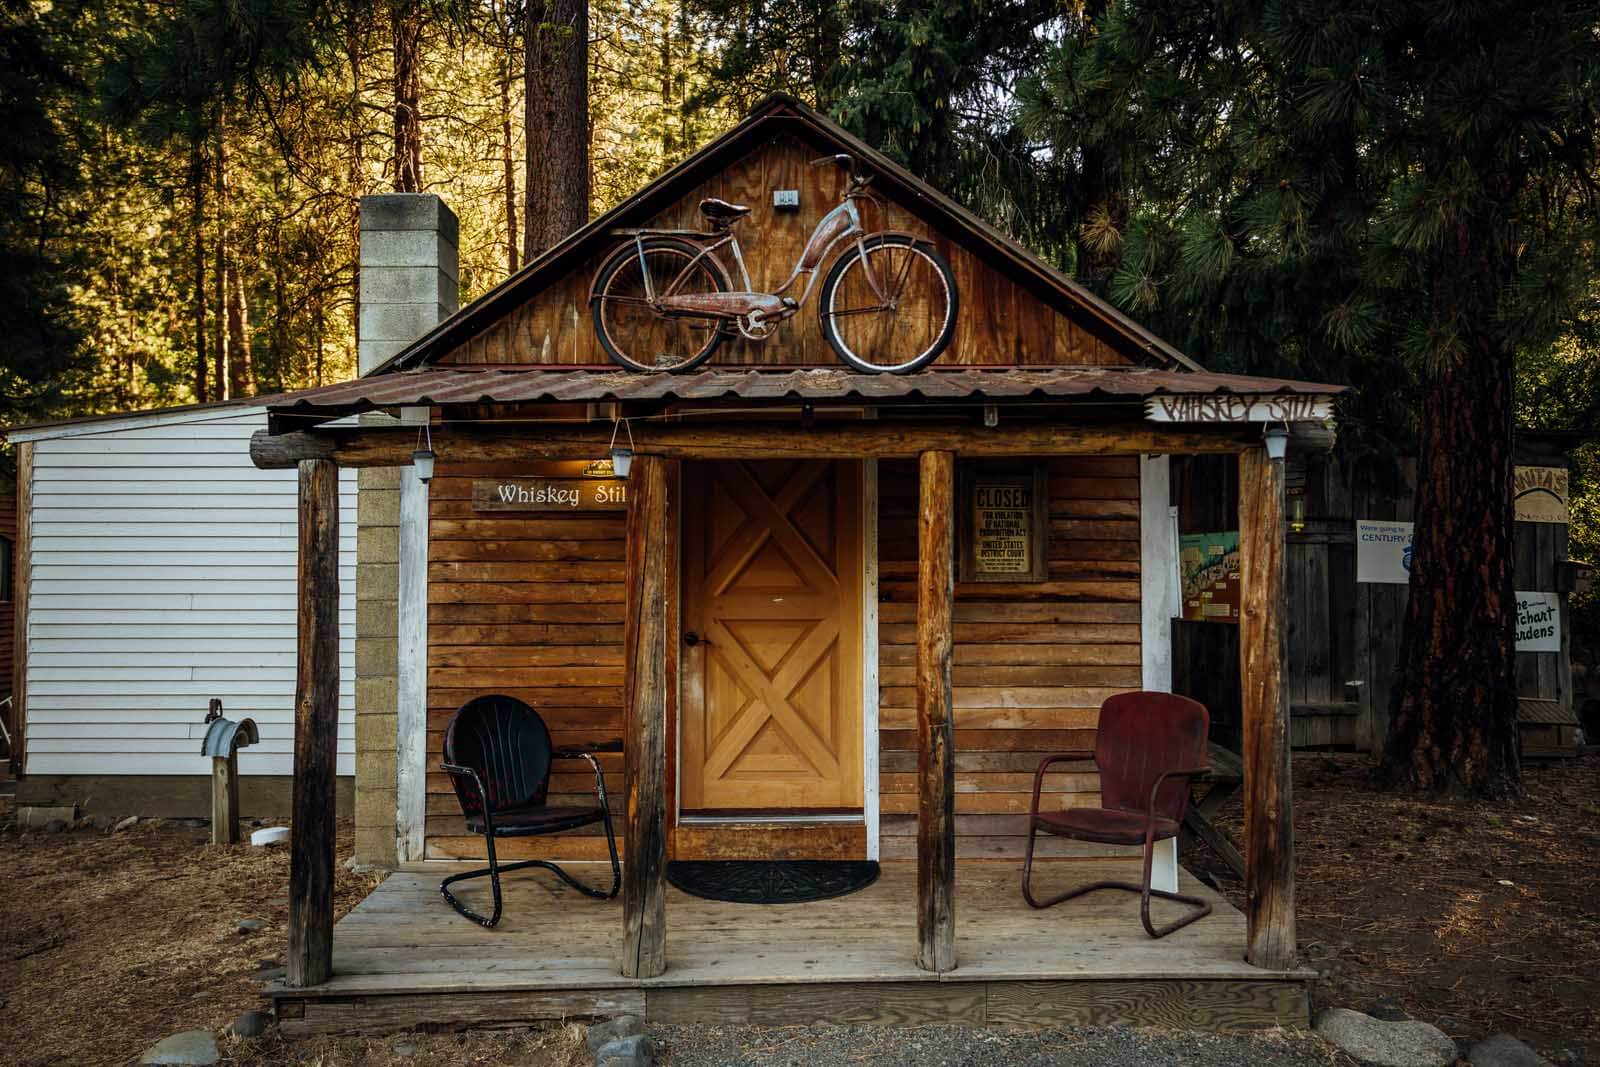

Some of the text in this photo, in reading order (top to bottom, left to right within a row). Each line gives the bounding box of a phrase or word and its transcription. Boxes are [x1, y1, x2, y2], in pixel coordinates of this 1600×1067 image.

[498, 484, 580, 506] Whiskey
[977, 488, 1032, 508] CLOSED
[993, 520, 1020, 528] NATIONAL
[979, 528, 1026, 537] PROHIBITION ACT
[1362, 534, 1406, 542] CENTURY
[982, 541, 1024, 549] UNITED STATES
[980, 549, 1025, 558] DISTRICT COURT
